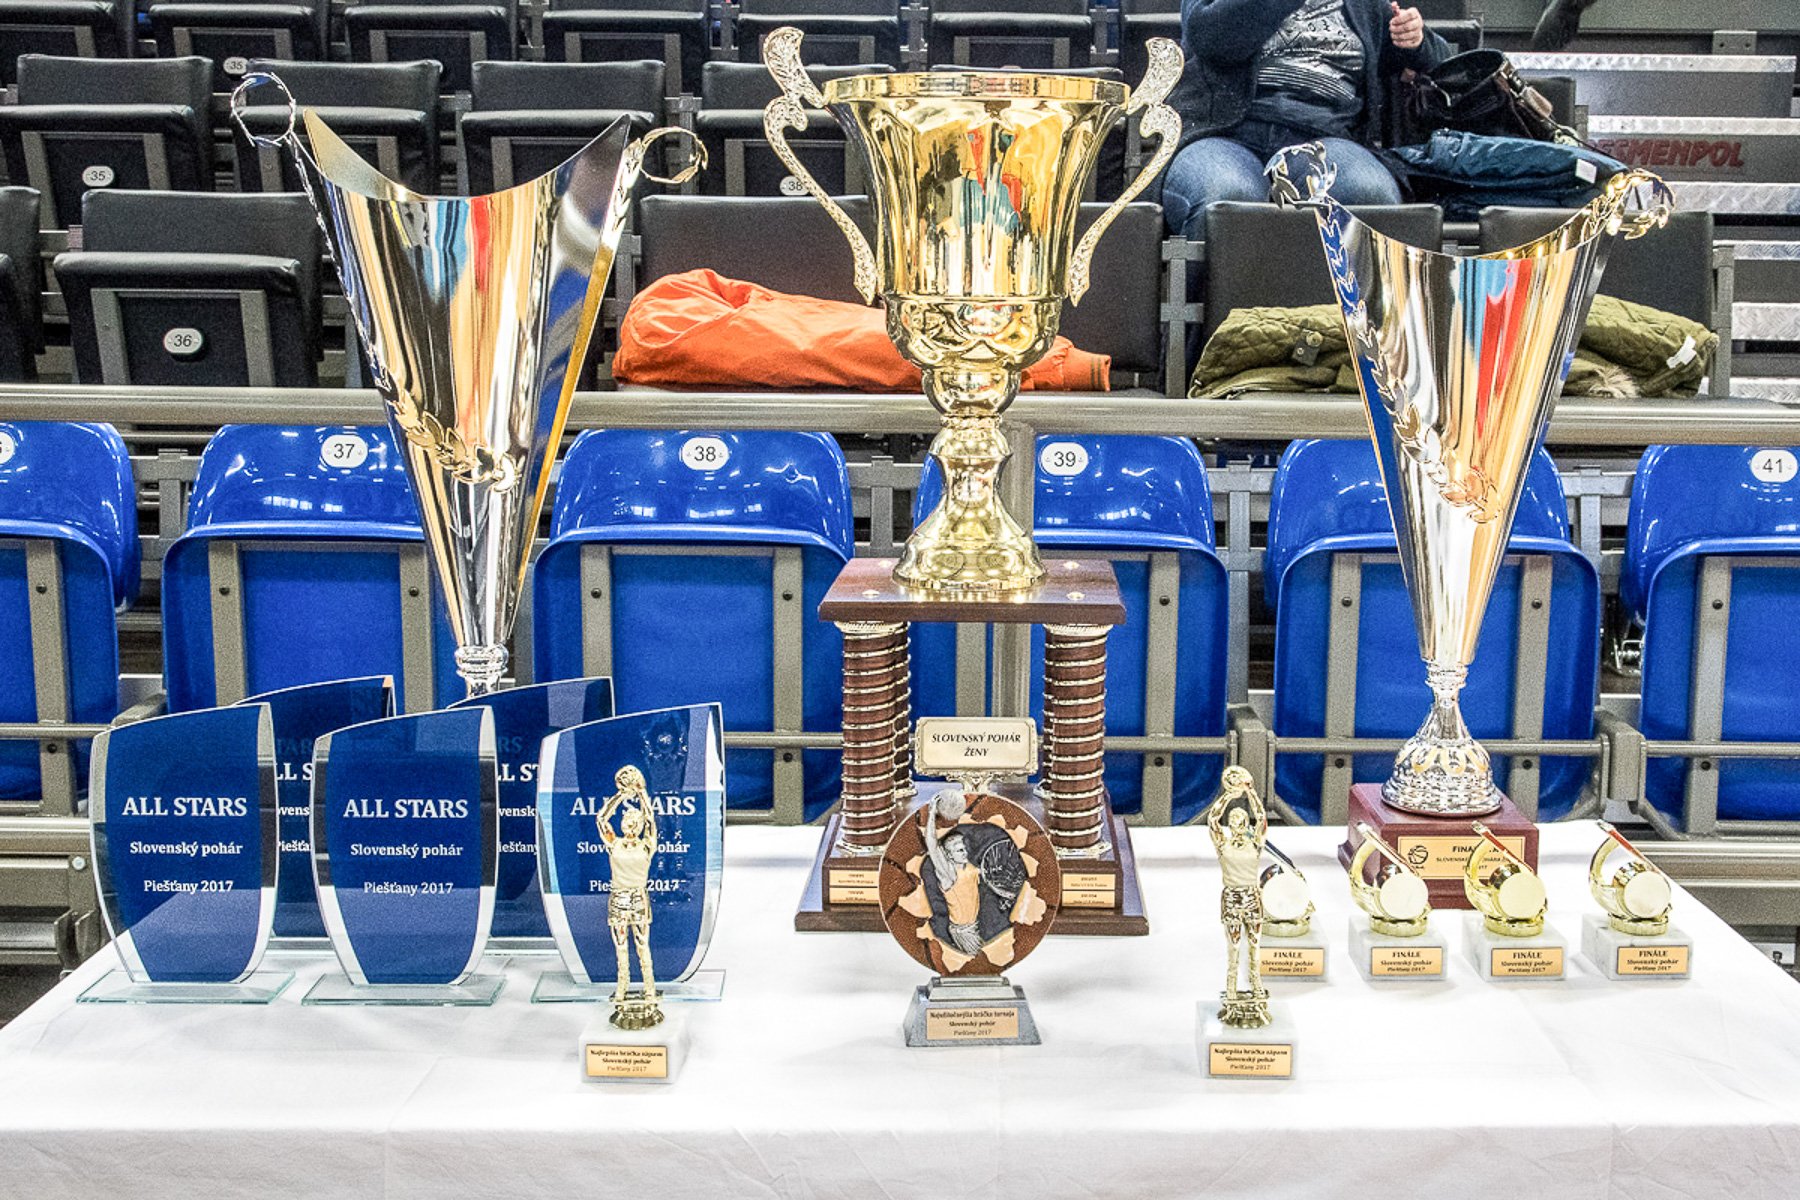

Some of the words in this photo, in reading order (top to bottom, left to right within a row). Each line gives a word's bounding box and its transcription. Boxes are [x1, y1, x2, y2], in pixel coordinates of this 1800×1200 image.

[90, 170, 106, 181] 35
[788, 181, 803, 191] 38
[173, 333, 192, 348] 36
[333, 443, 355, 459] 37
[694, 445, 716, 462] 38
[1053, 451, 1076, 467] 39
[1762, 458, 1783, 473] 41
[932, 731, 986, 743] SLOVENSKÝ
[987, 732, 1021, 743] POHÁR
[964, 747, 989, 757] ŽENY
[121, 796, 169, 816] ALL
[173, 797, 248, 817] STARS
[343, 799, 389, 818] ALL
[394, 799, 469, 819] STARS
[130, 841, 199, 857] Slovenský
[201, 841, 243, 857] pohár
[350, 843, 420, 858] Slovenský
[422, 844, 464, 859] pohár
[657, 841, 691, 853] ohár
[143, 880, 199, 895] Piešťany
[200, 880, 234, 892] 2017
[363, 881, 418, 896] Piešťany
[420, 882, 454, 894] 2017
[1513, 951, 1543, 959] FINÁLE
